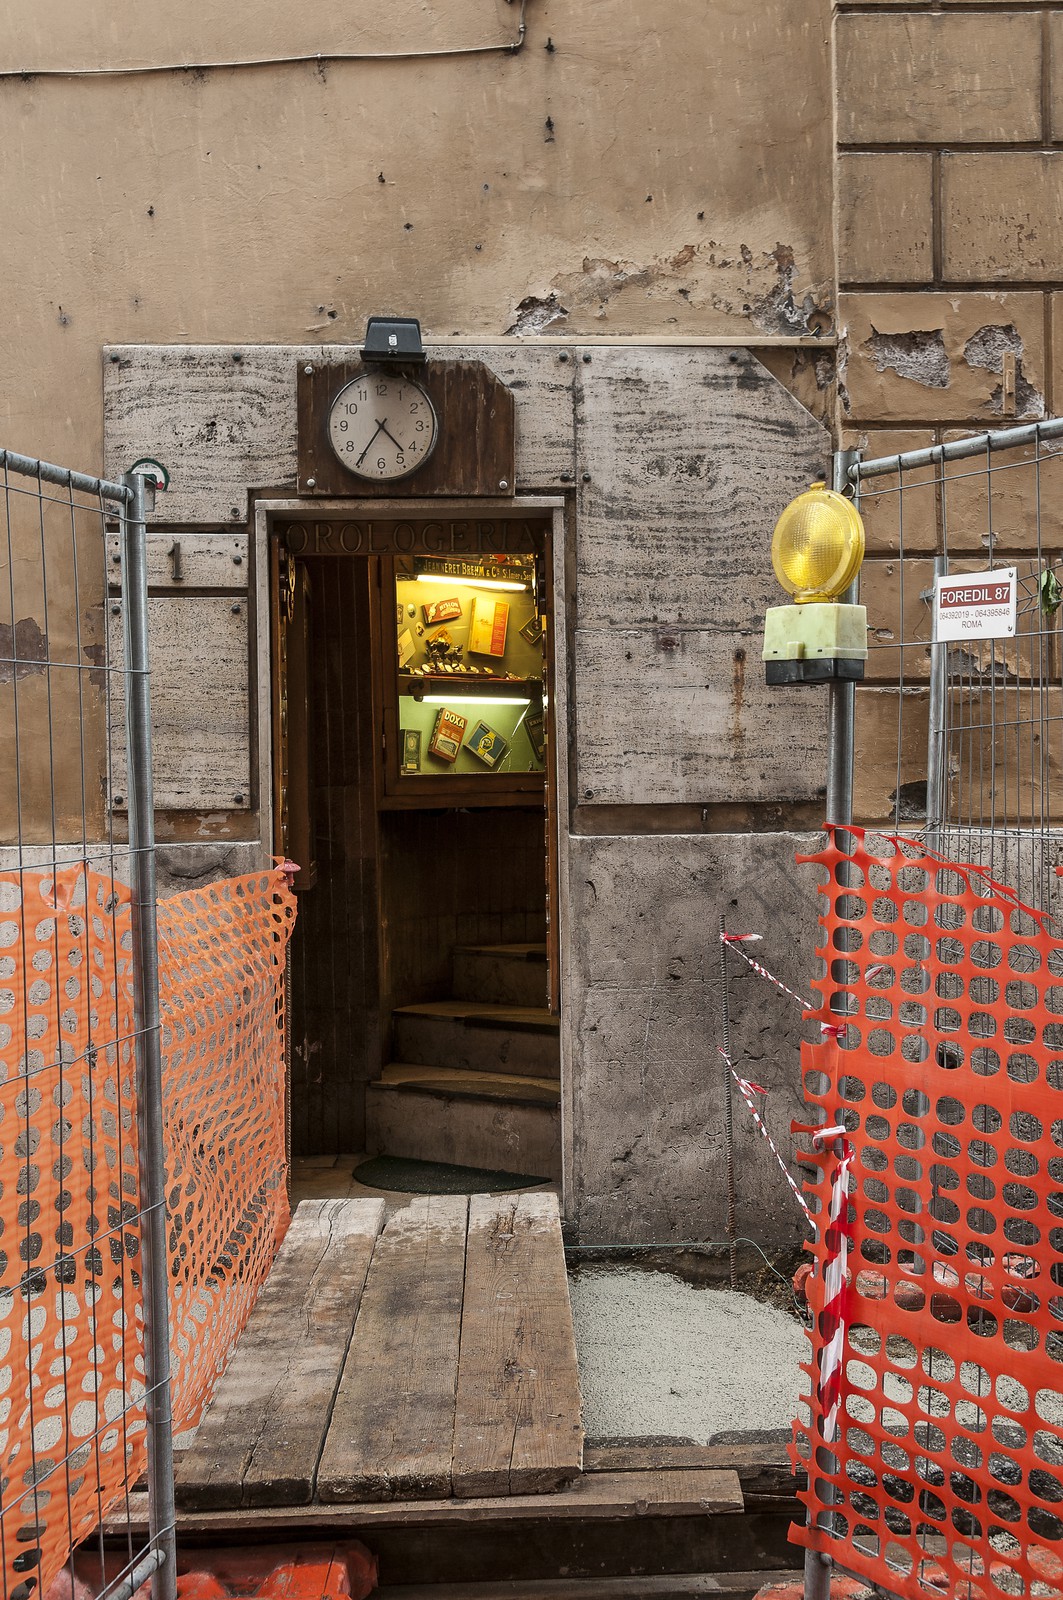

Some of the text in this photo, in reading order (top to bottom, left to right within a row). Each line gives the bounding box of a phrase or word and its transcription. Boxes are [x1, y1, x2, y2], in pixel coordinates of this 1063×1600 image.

[375, 384, 387, 396] 12
[358, 391, 368, 401] 11
[345, 403, 358, 415] 10
[409, 403, 418, 414] 2
[340, 421, 348, 432] 9
[415, 421, 424, 432] 3
[346, 441, 354, 452] 8
[408, 441, 417, 452] 4
[359, 452, 367, 464] 7
[377, 457, 386, 469] 6
[396, 453, 404, 464] 5
[286, 524, 537, 553] OROLOGERIA
[168, 541, 184, 580] 1
[423, 559, 460, 574] JEANNERET
[462, 562, 485, 577] BREHM
[941, 587, 1009, 604] FOREDIL 87
[975, 607, 1010, 618] 064395846
[962, 620, 982, 628] ROMA
[444, 711, 465, 729] DOXA
